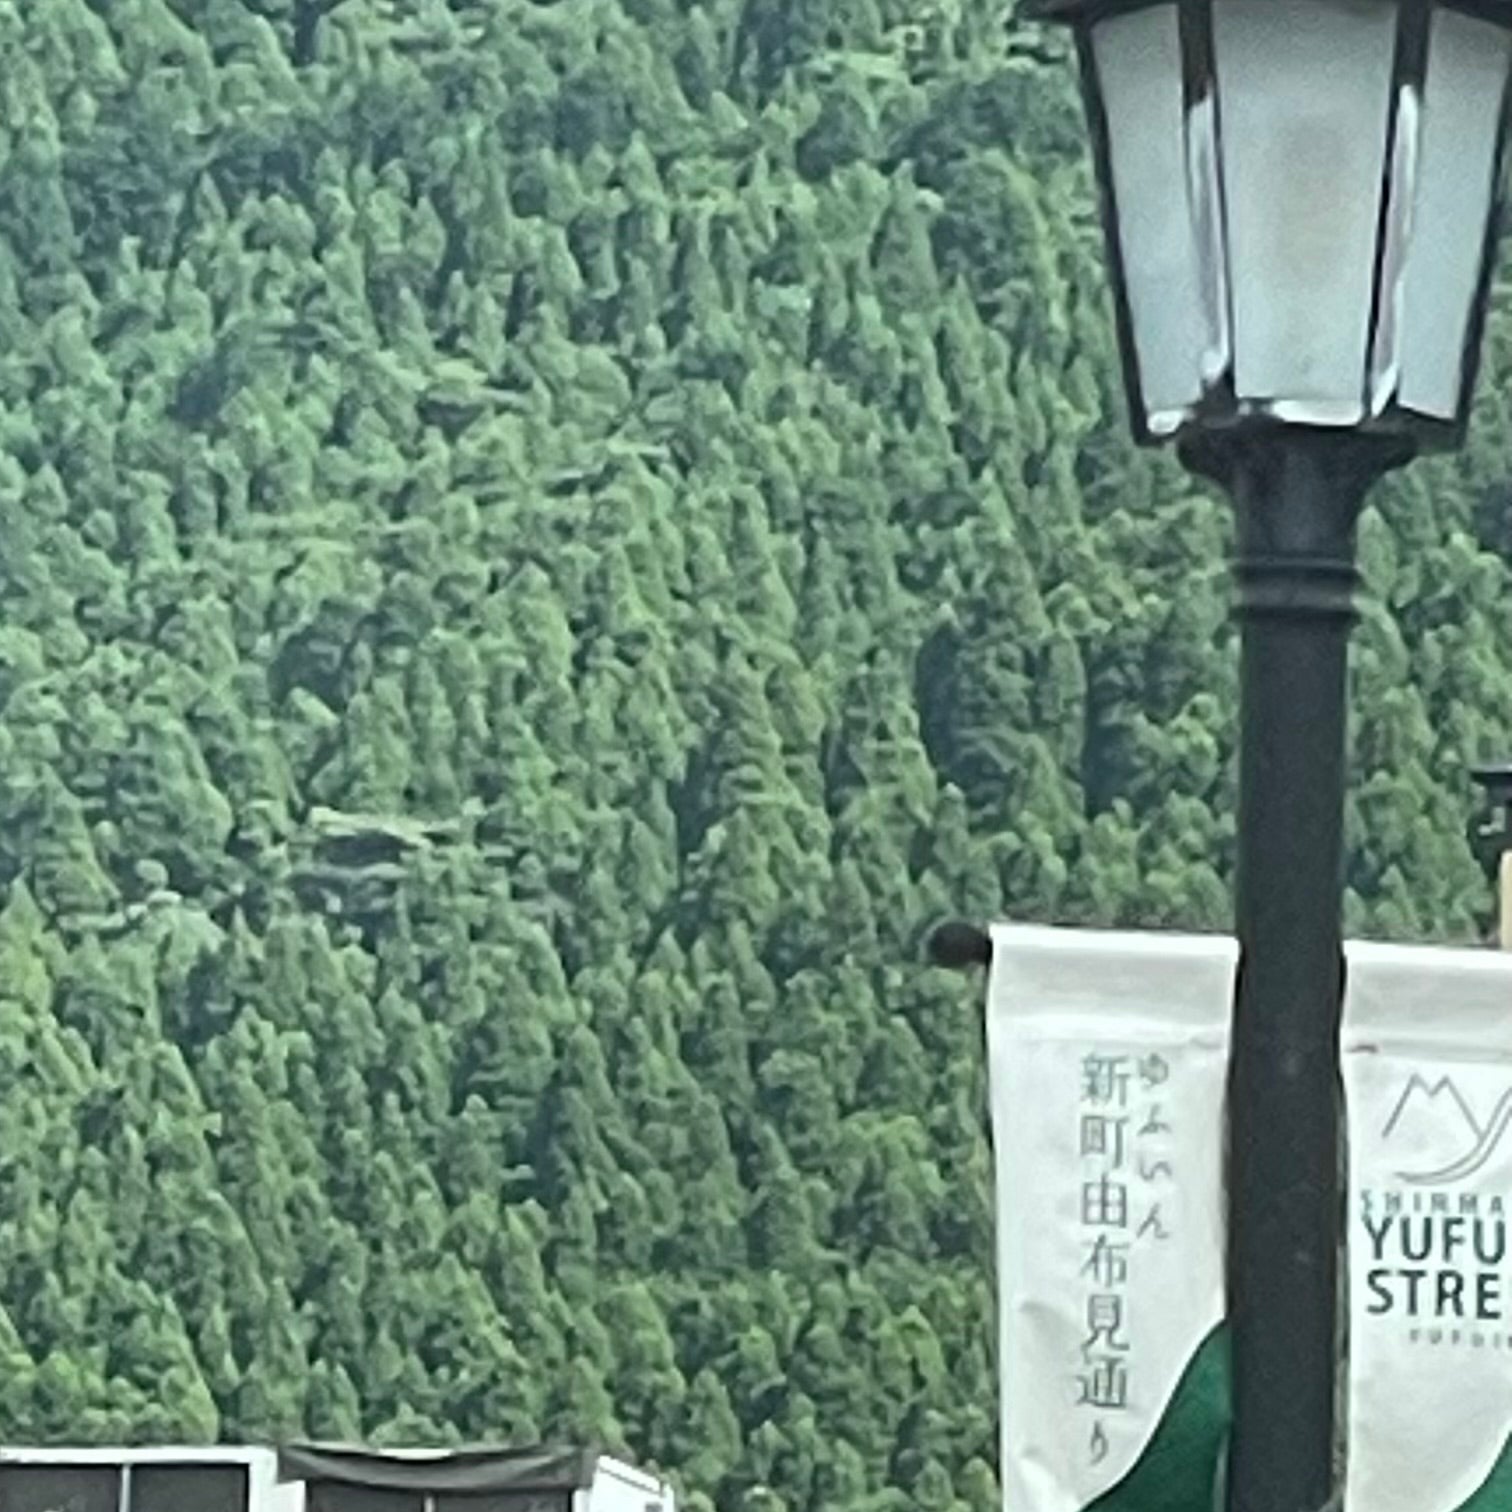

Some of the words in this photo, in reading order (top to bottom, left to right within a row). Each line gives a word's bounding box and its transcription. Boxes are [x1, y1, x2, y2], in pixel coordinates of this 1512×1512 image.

[1076, 1052, 1131, 1466] 新町由布見通り
